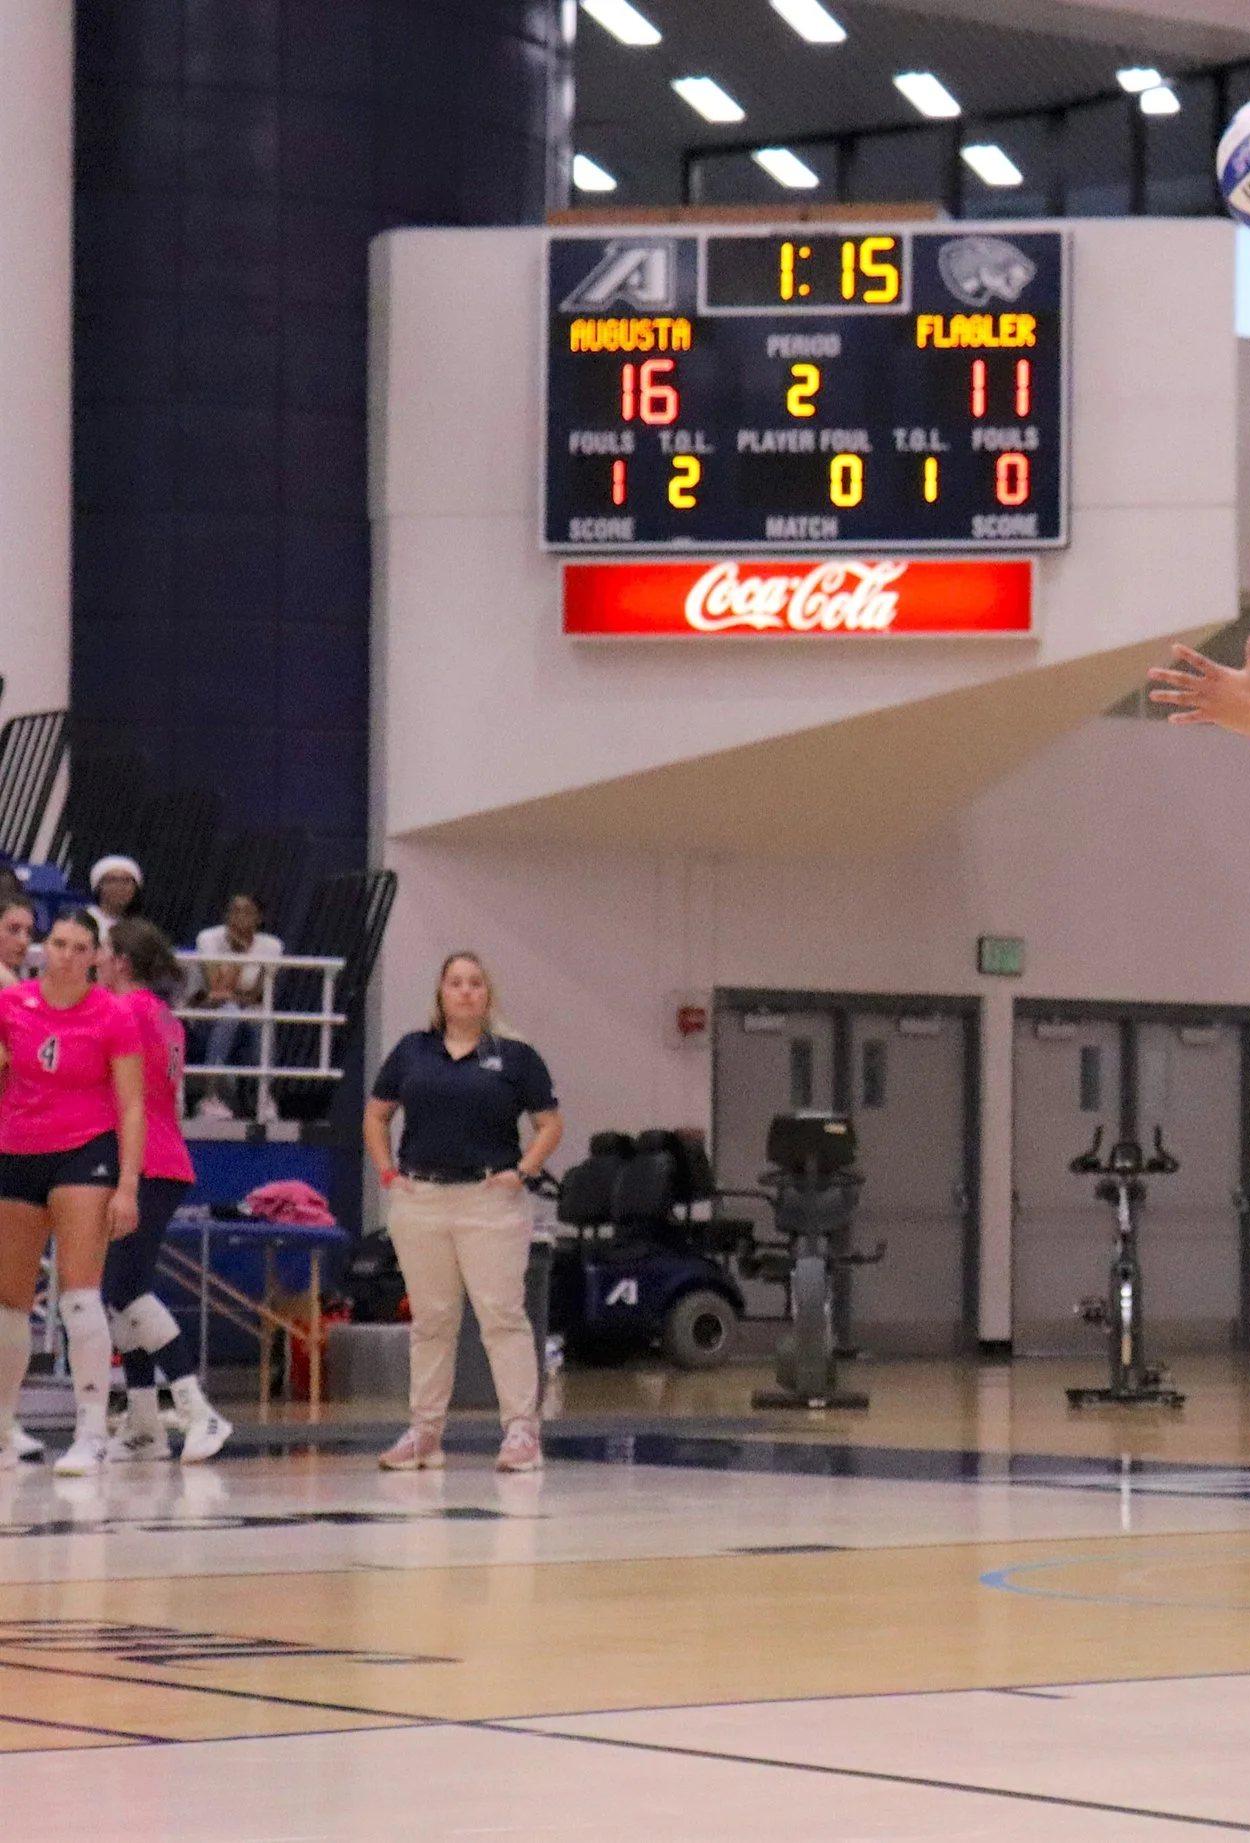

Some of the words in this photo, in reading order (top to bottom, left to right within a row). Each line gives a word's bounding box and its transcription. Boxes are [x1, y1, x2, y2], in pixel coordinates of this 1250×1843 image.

[570, 317, 692, 352] AUGUSTA
[767, 333, 841, 358] PERIOD
[916, 313, 1037, 349] FLAGLER
[621, 358, 679, 425] 16
[786, 363, 821, 417] 2
[971, 358, 1032, 418] 11
[569, 430, 635, 454] FOULS
[737, 428, 815, 453] PLAYER
[820, 428, 872, 453] FOUL
[971, 425, 1040, 450] FOULS
[612, 459, 627, 505] 1
[668, 455, 701, 509] 2
[830, 453, 863, 508] 0
[924, 456, 938, 503] 1
[996, 452, 1030, 506] 0
[568, 517, 635, 541] SCORE
[765, 515, 839, 540] MATCH
[970, 513, 1039, 538] SCORE
[684, 560, 909, 632] Coca-Cola
[38, 1036, 60, 1074] 4
